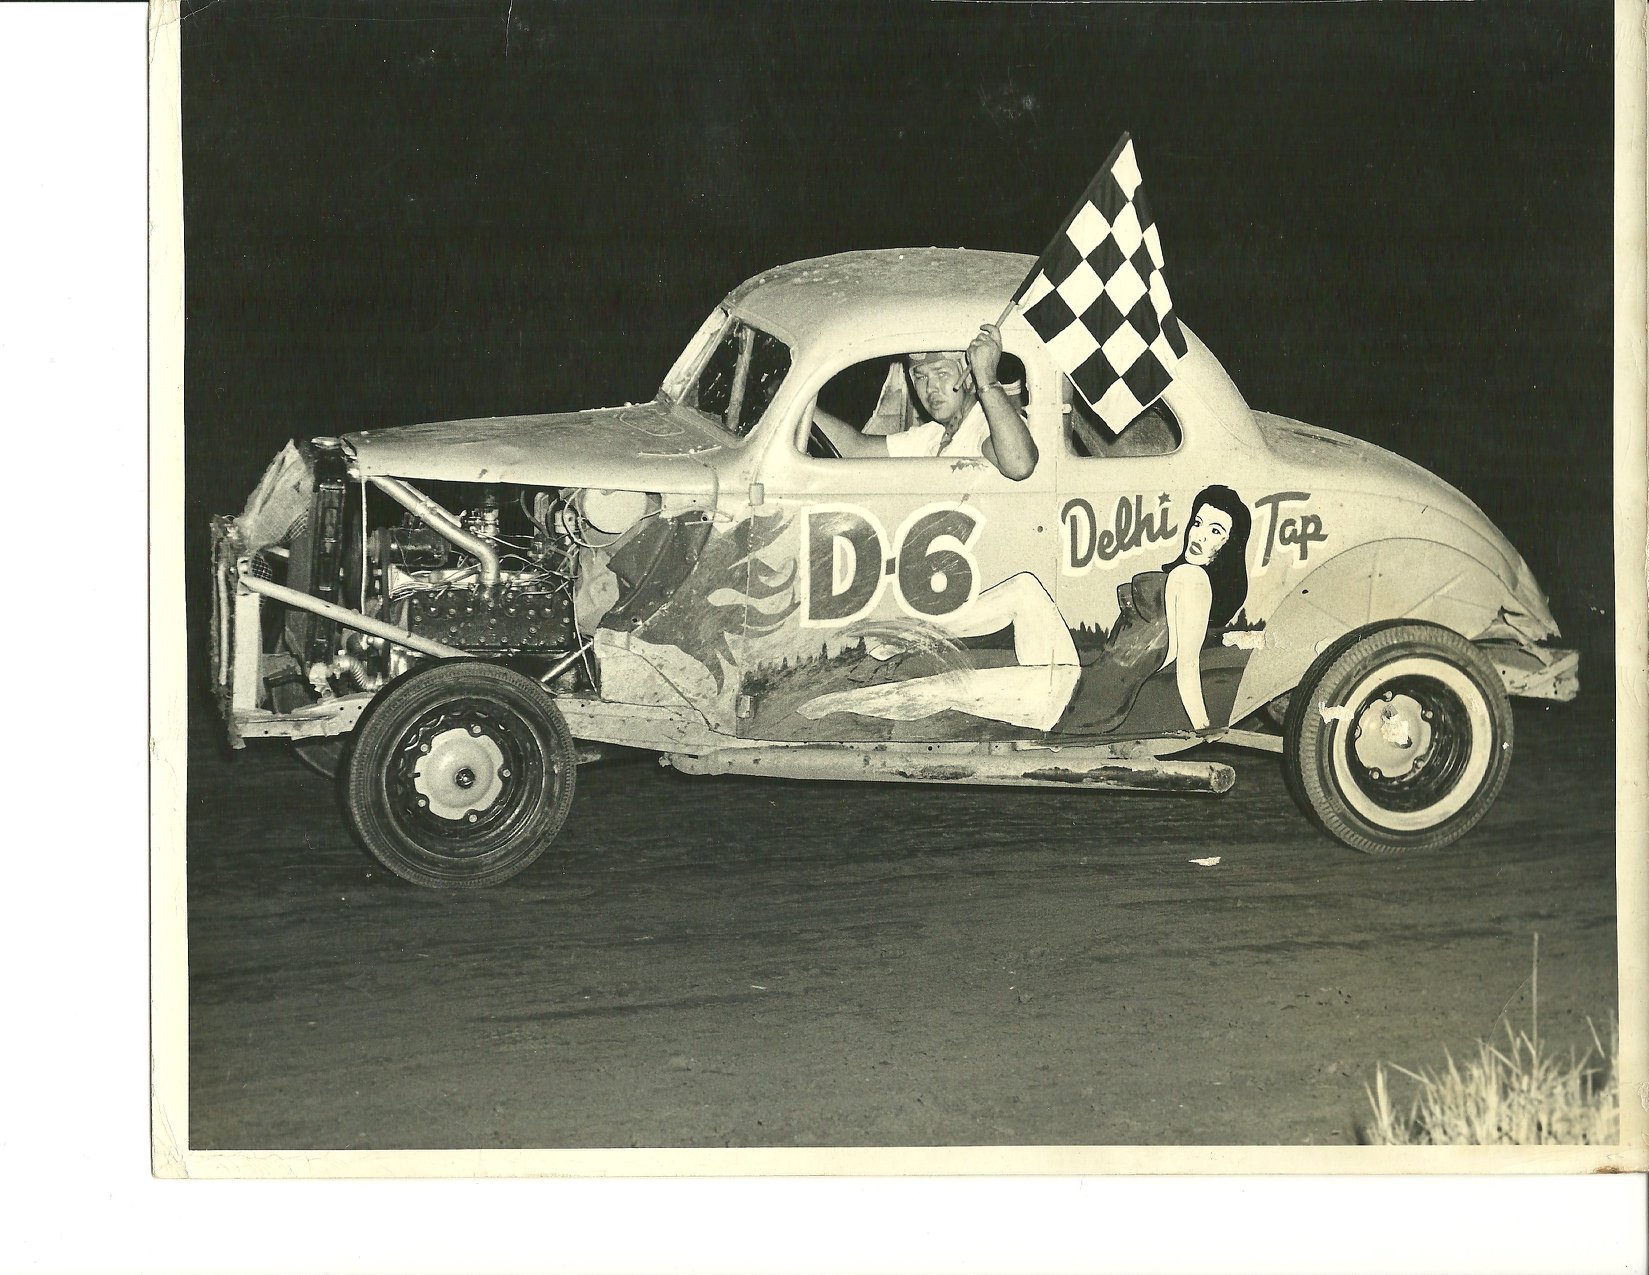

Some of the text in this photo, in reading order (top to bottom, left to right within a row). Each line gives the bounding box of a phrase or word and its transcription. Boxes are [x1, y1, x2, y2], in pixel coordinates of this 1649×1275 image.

[805, 505, 980, 624] D-6
[1061, 491, 1329, 568] Delhi Tap
